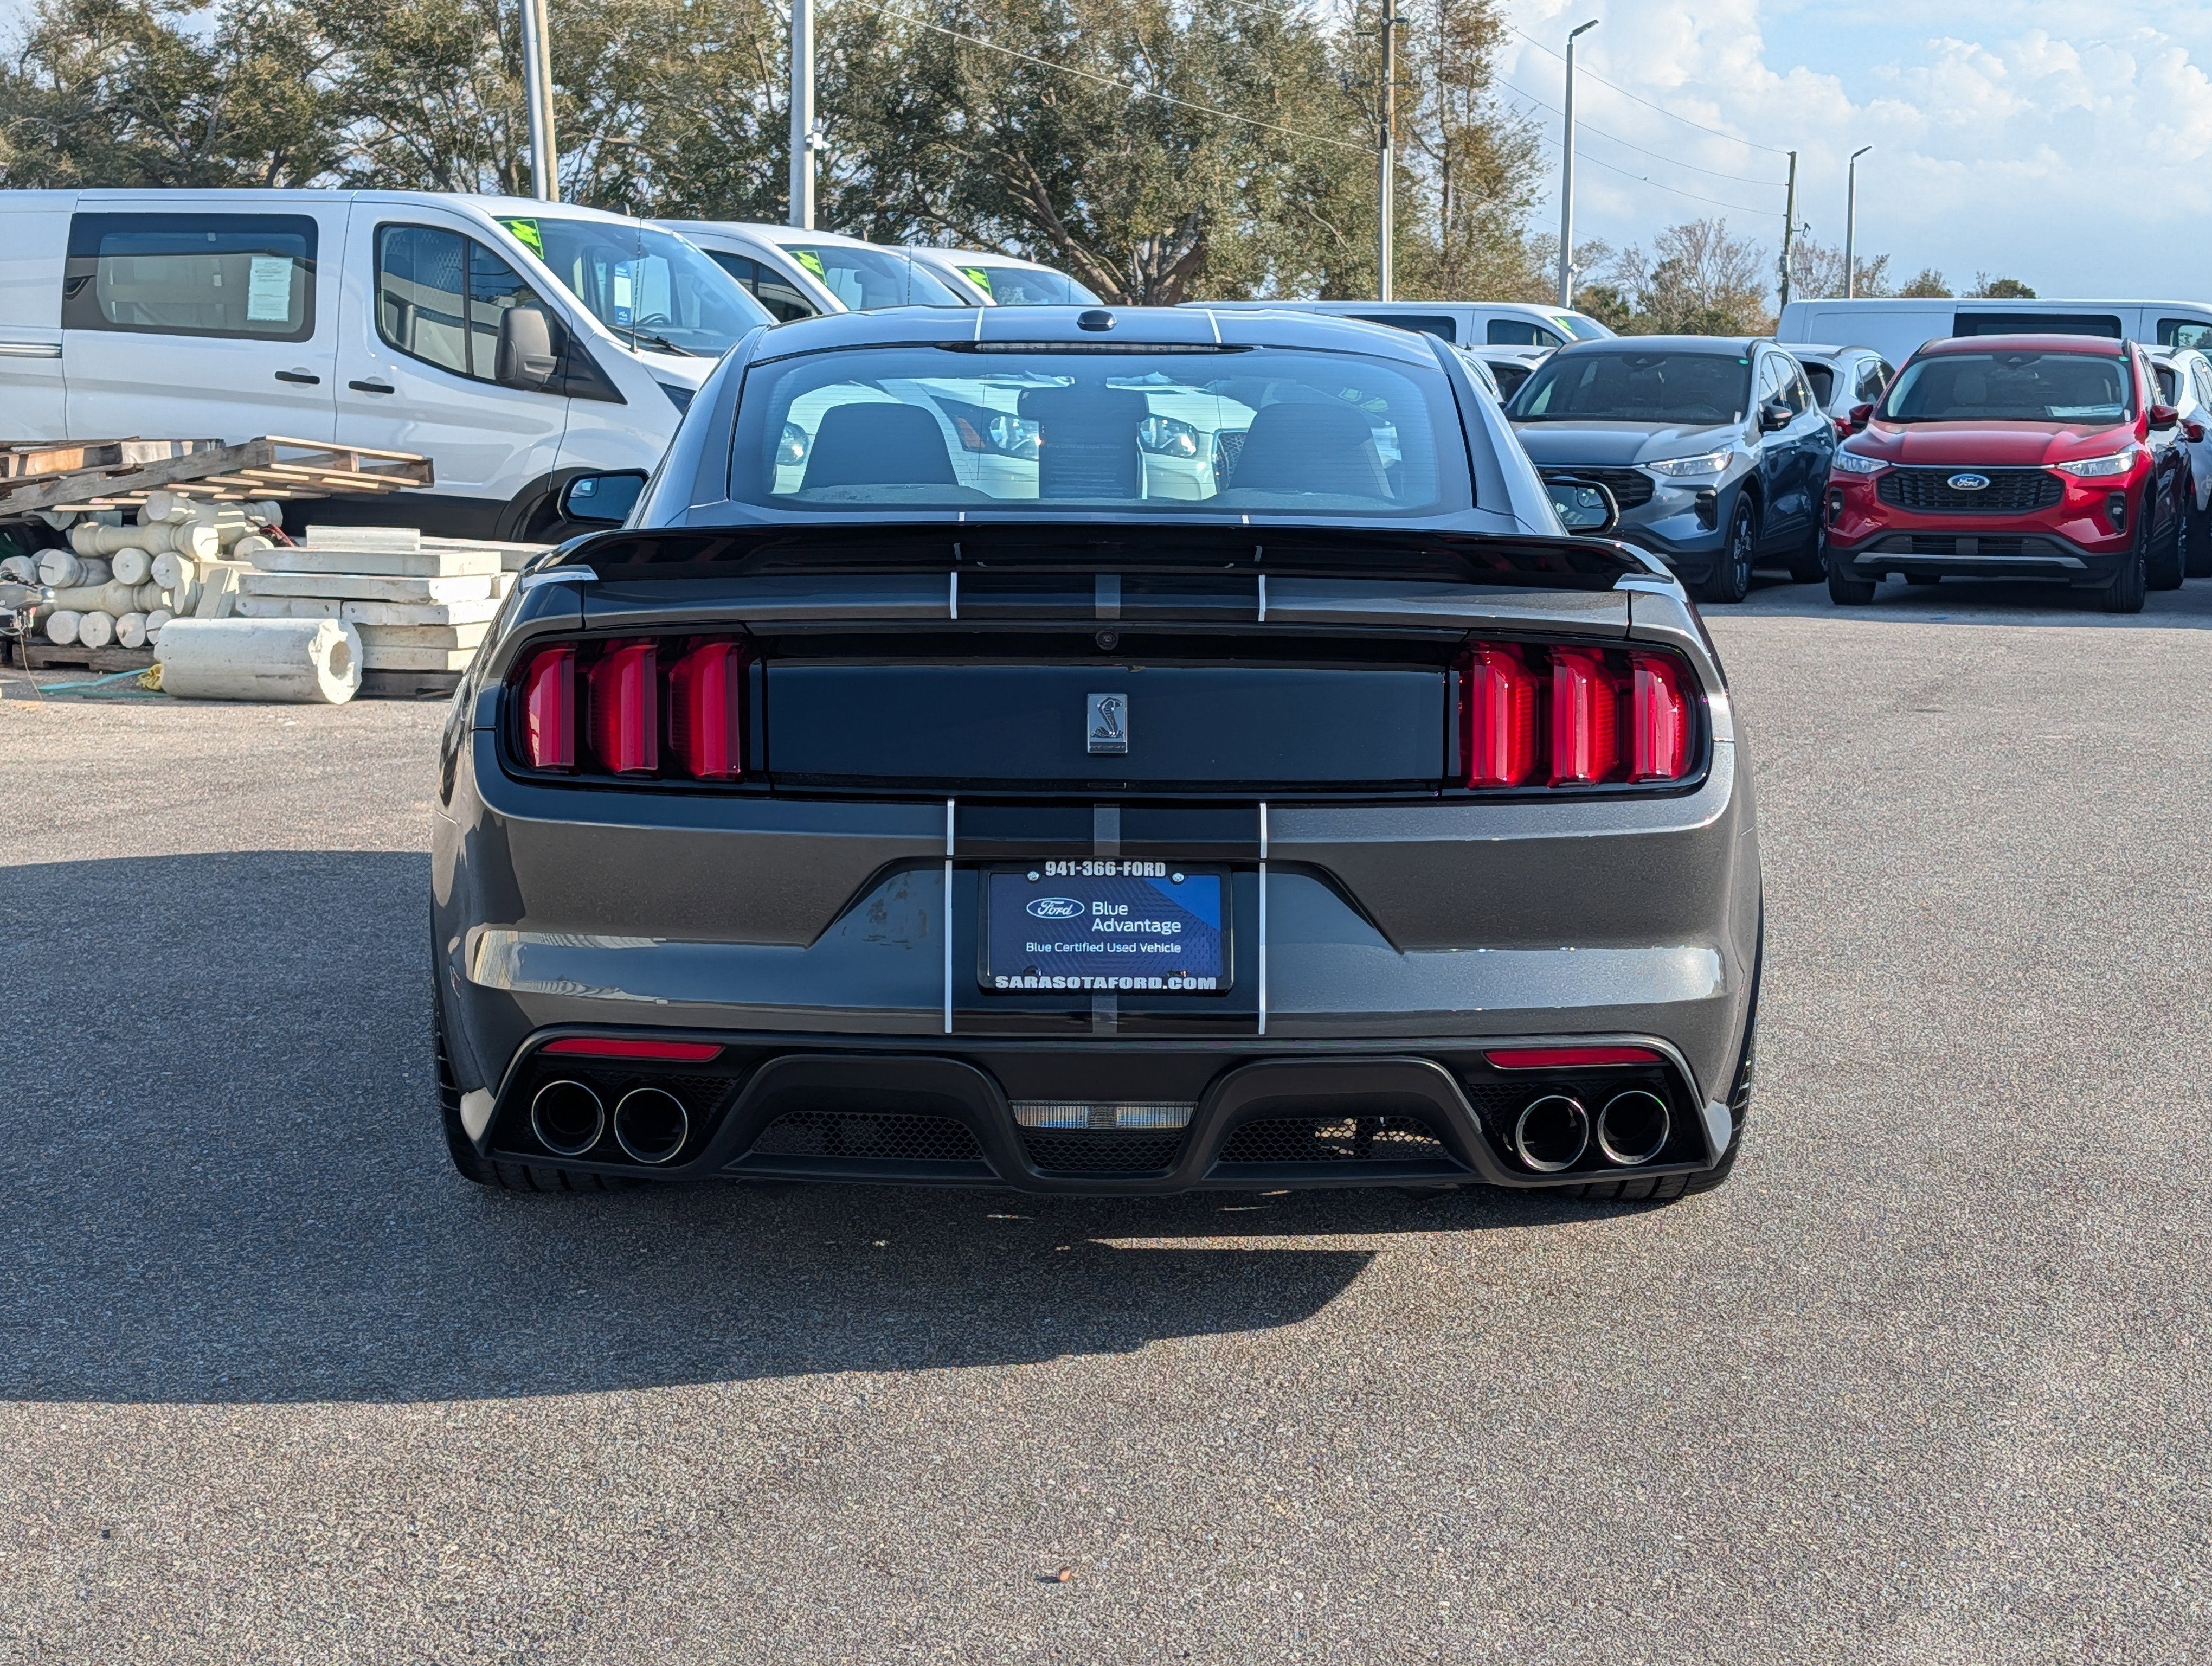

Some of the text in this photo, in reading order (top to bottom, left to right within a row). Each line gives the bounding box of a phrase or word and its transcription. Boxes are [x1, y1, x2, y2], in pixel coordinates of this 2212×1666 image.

[1045, 861, 1166, 877] 941-366-FORD
[1037, 900, 1073, 915] Ford
[1092, 901, 1128, 915] Blue
[1091, 918, 1181, 935] Advantage
[1026, 942, 1181, 953] Blue Certified Used Vehicle
[995, 976, 1217, 990] SARASOTAFORD.COM
